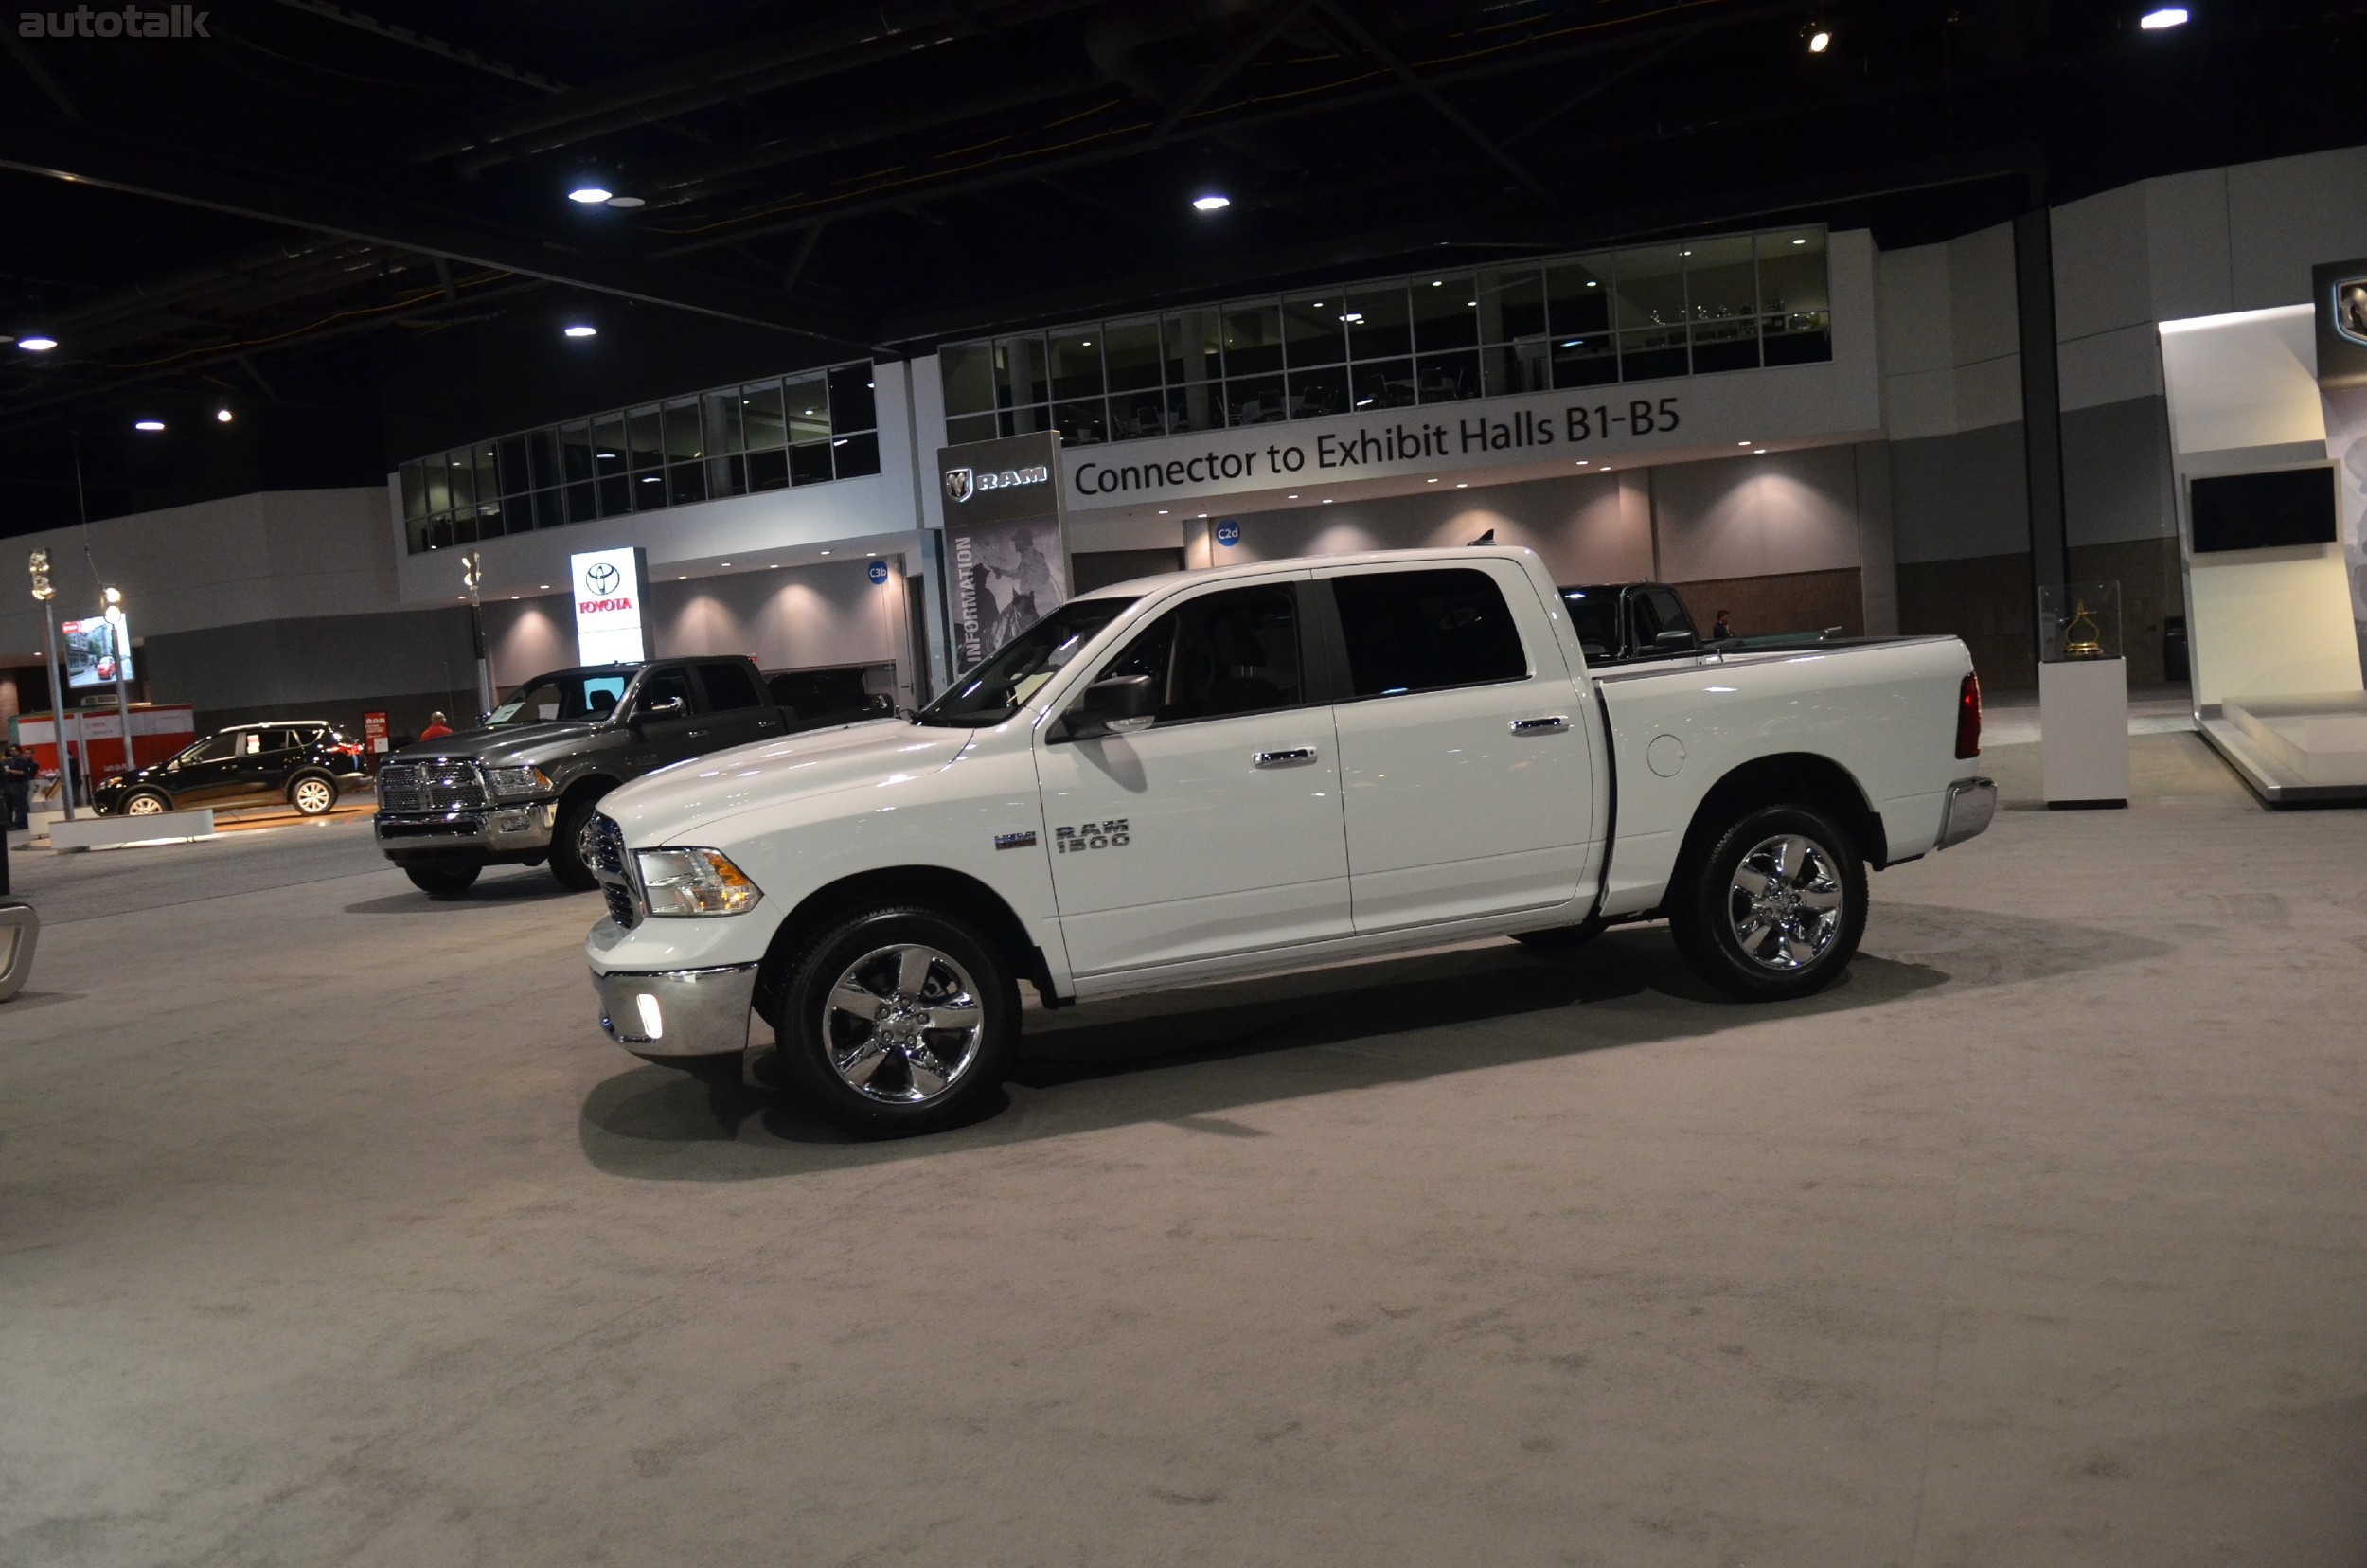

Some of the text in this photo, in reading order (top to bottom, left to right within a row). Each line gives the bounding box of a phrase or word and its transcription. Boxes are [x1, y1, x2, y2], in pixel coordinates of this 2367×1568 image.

[1075, 397, 1680, 495] Connector to Exhibit Halls B1-B5
[976, 466, 1048, 490] RAM
[1218, 526, 1238, 540] C2d
[869, 567, 887, 578] C3b
[578, 597, 632, 615] TOYOTA
[955, 536, 982, 662] INFORMATION
[1056, 818, 1129, 841] RAM
[1056, 832, 1130, 854] 1500
